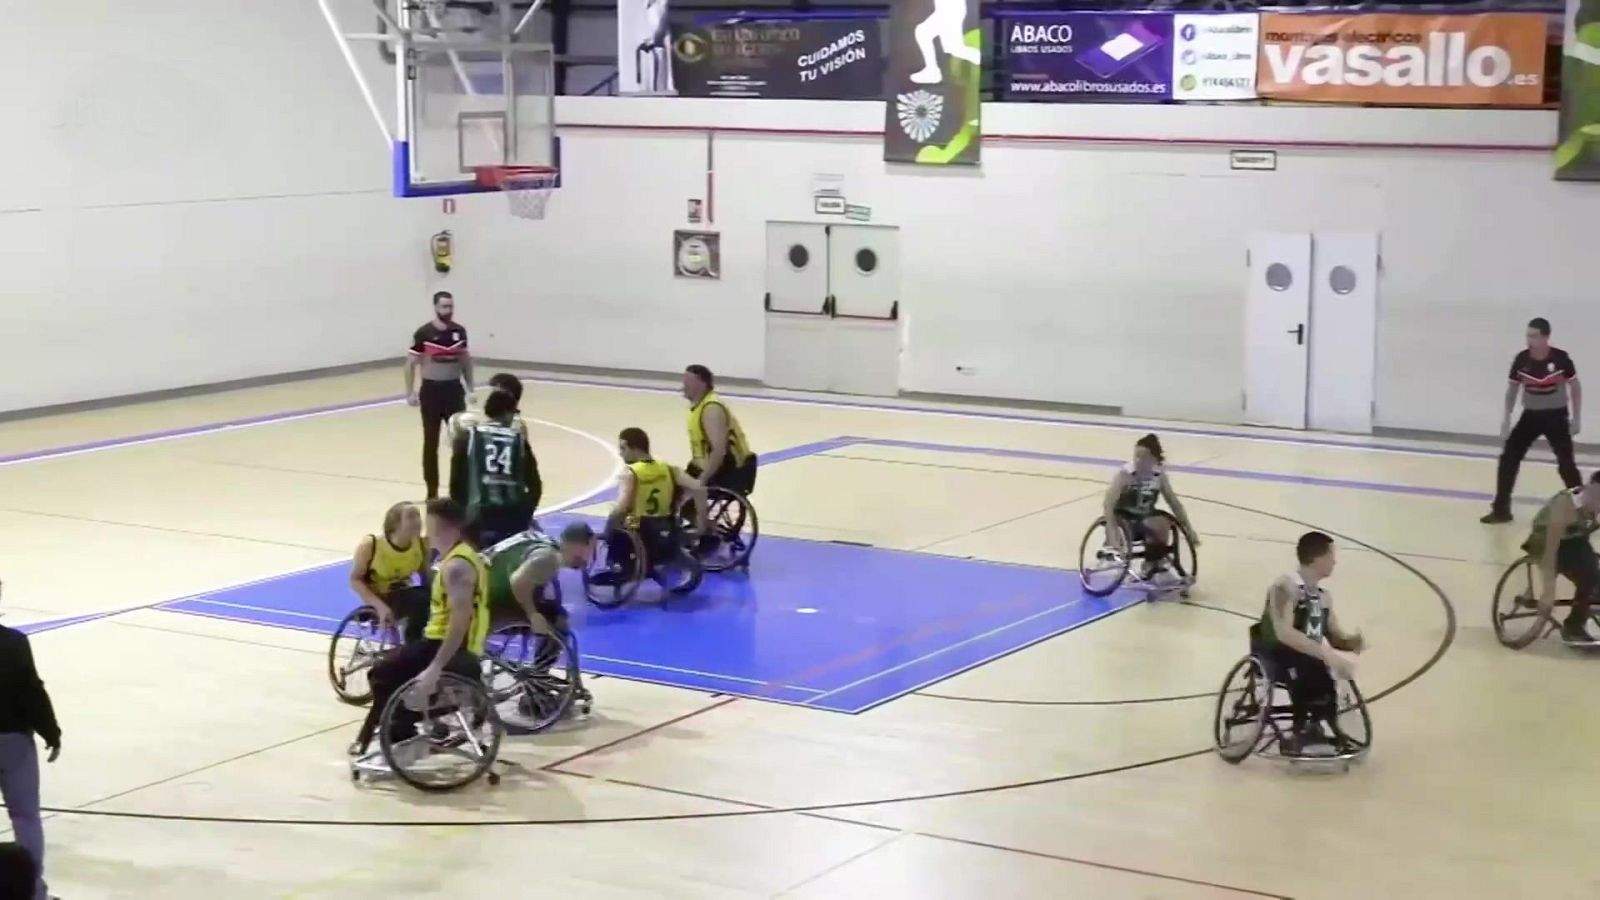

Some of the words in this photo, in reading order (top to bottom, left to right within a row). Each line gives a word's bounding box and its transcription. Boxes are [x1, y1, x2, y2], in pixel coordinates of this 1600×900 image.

[797, 29, 866, 67] CUIDAMOS
[799, 71, 818, 82] TU
[820, 47, 866, 76] VISIÓN
[1010, 80, 1166, 93] www.abacolibrosusados.es
[485, 444, 512, 475] 24
[645, 488, 661, 515] 5
